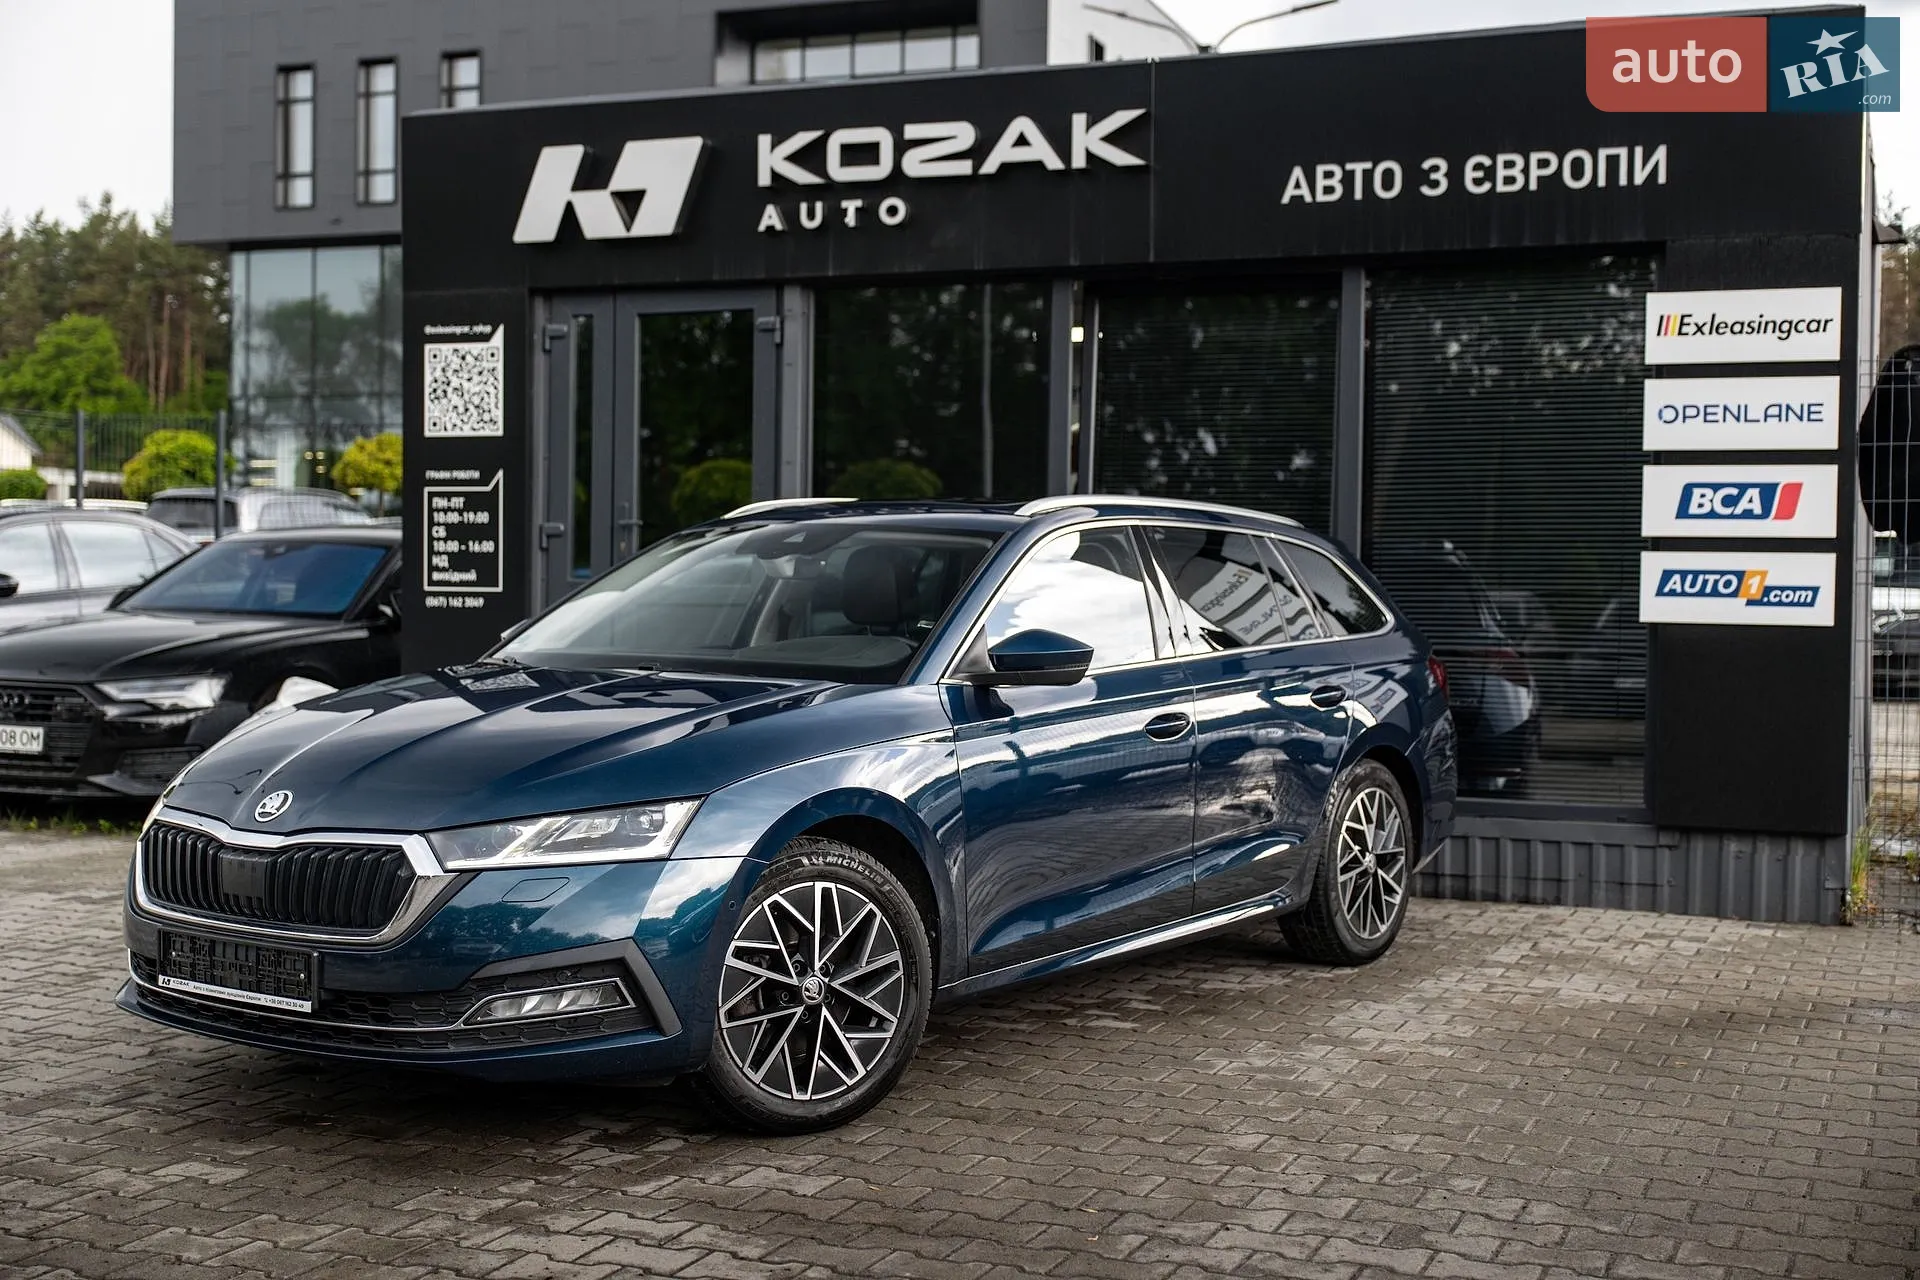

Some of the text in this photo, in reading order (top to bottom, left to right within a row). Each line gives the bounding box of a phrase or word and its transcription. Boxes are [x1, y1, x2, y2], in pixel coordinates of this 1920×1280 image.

[757, 107, 1148, 188] KOZAK
[1280, 143, 1669, 205] АВТО З ЄВРОПИ
[757, 196, 908, 233] AUTO
[1676, 312, 1834, 341] Exleasingcar
[1657, 402, 1825, 424] OPENLANE
[432, 496, 465, 509] ПН-ПТ
[1688, 486, 1765, 516] BCA
[431, 525, 447, 539] СБ
[826, 854, 885, 885] MICHELIN
